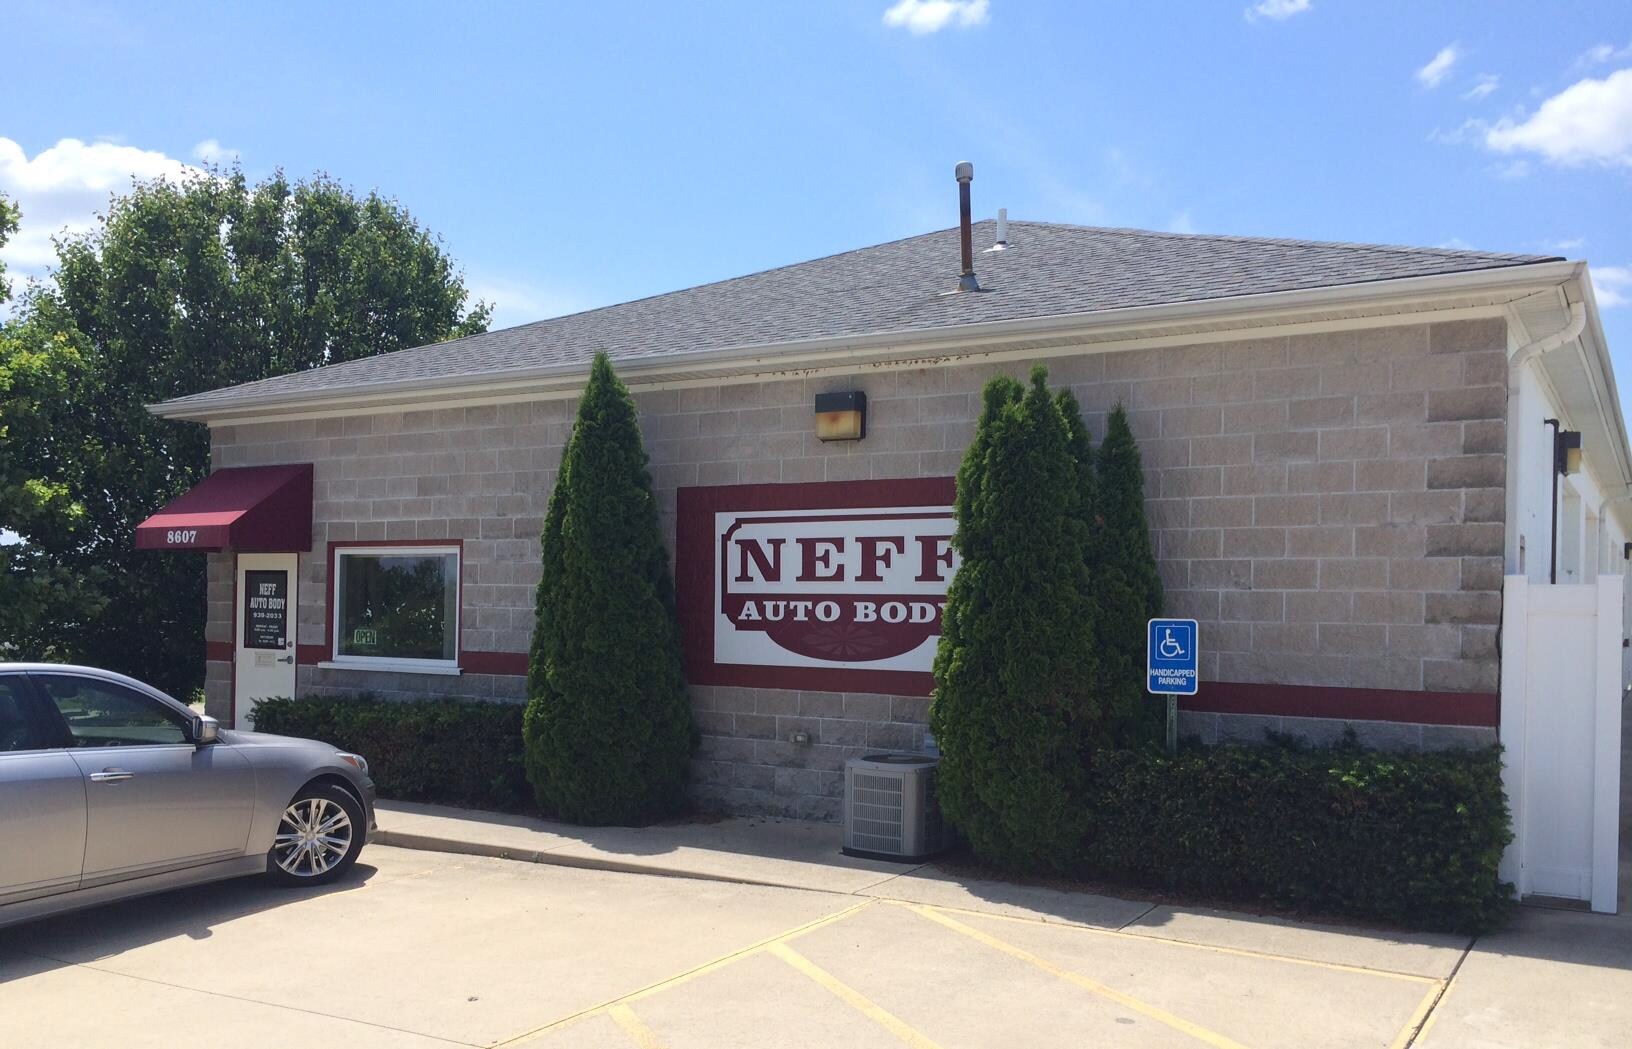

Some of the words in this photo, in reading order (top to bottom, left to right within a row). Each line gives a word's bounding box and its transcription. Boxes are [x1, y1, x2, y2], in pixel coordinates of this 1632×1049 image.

[167, 530, 196, 544] 8607
[735, 536, 952, 582] NEFF
[259, 583, 276, 595] NEFF
[250, 597, 267, 609] AUTO
[268, 598, 285, 610] BODY
[738, 600, 841, 622] AUTO
[853, 601, 945, 624] BOD
[356, 630, 375, 643] OPEN
[1150, 668, 1195, 677] HANDICAPPED
[1158, 677, 1187, 686] PARKING
